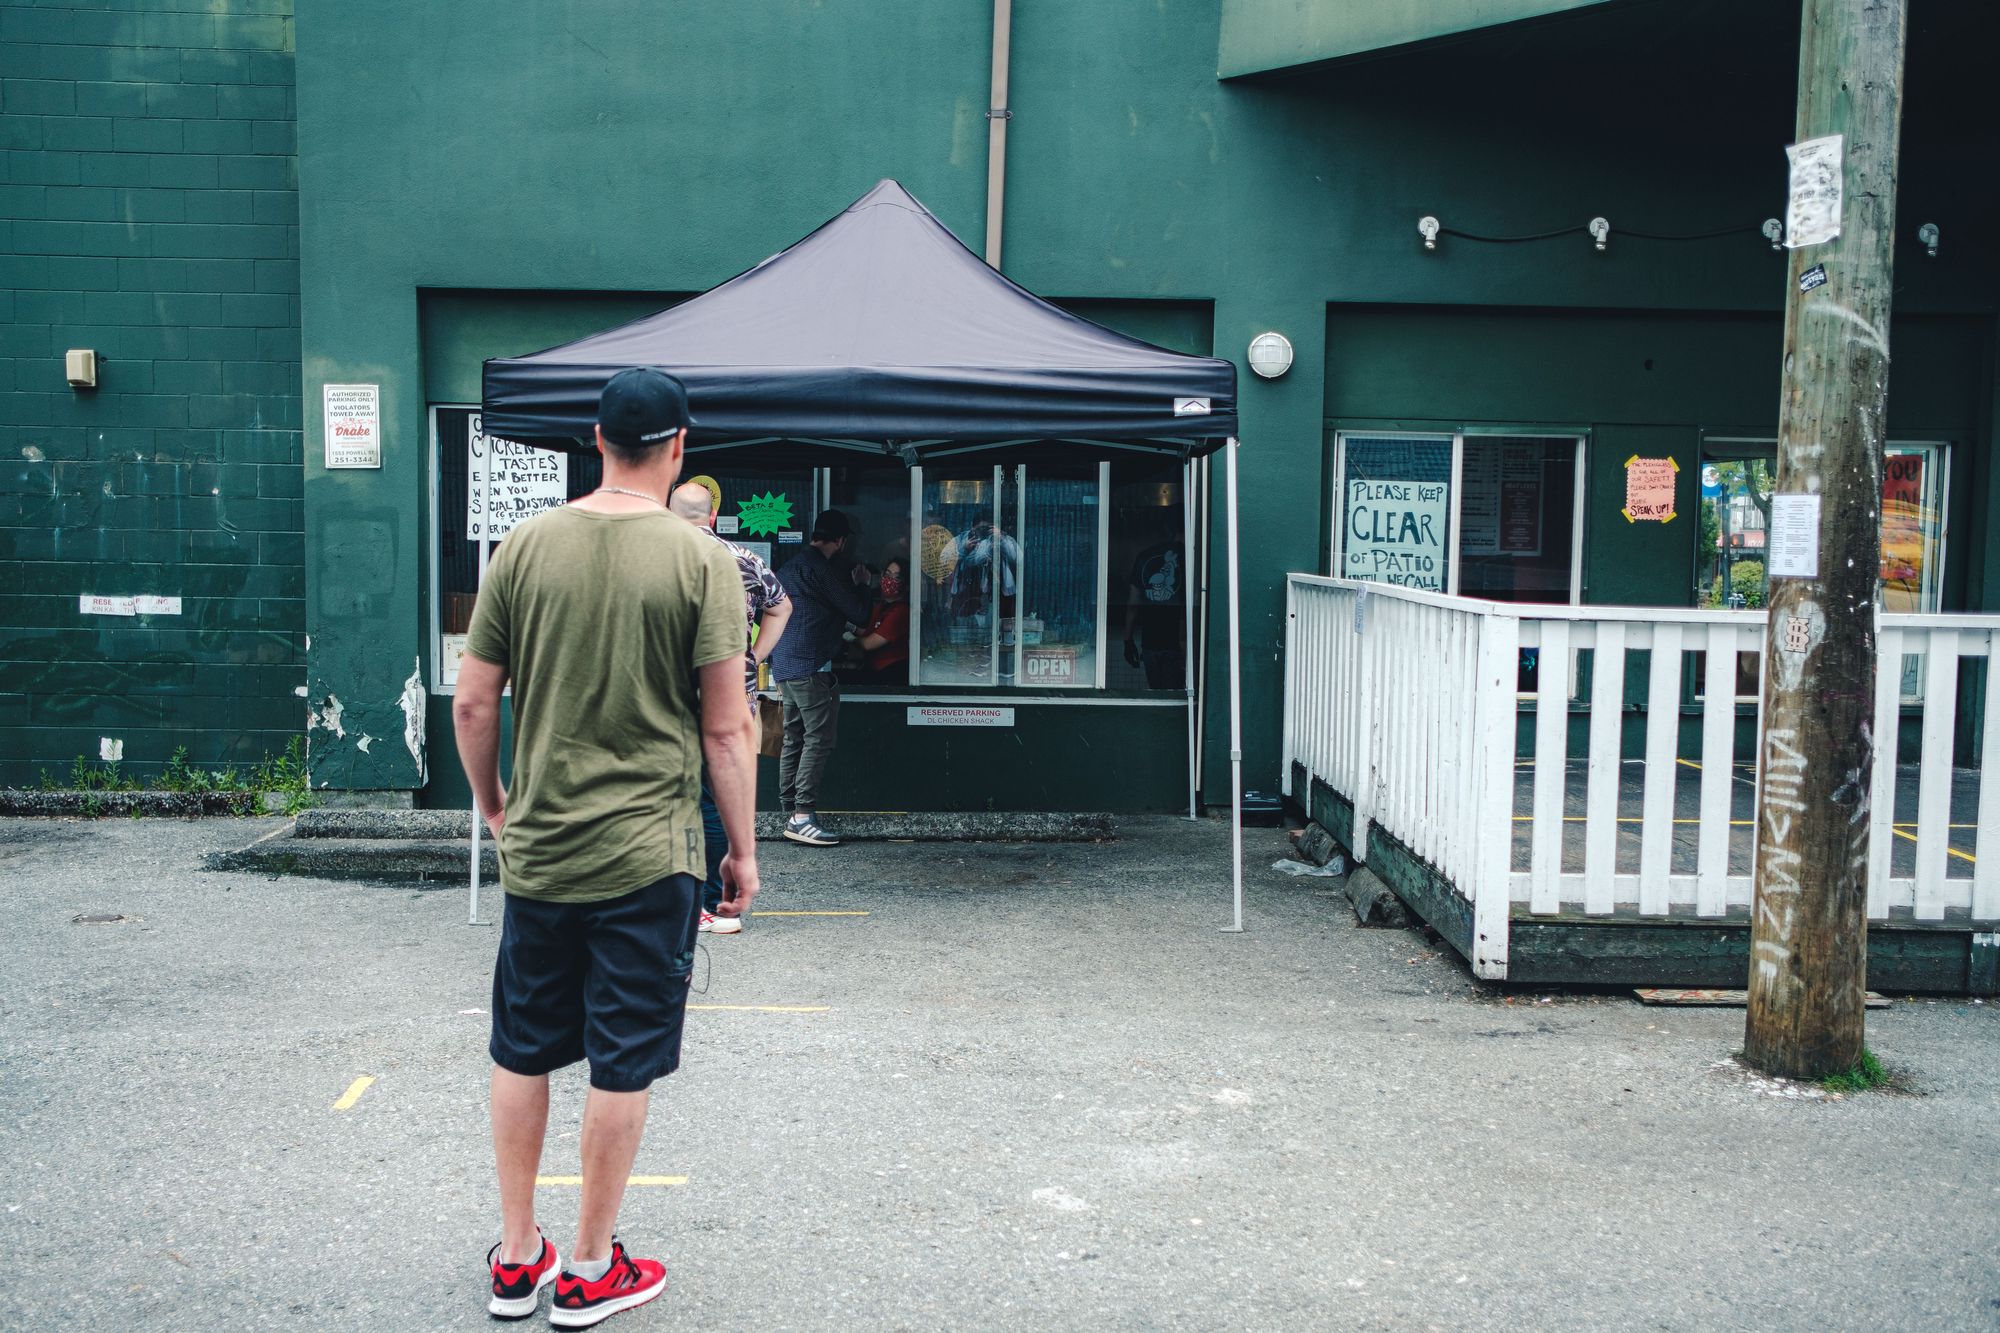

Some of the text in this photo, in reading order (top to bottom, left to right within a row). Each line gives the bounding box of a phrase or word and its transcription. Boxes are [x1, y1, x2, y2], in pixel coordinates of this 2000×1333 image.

[335, 425, 370, 436] Drake
[472, 435, 535, 458] CICKEN
[499, 455, 559, 471] TASTES
[473, 471, 560, 483] EEN BETTER
[473, 487, 501, 498] WEN
[1353, 481, 1444, 503] PLEASE KEEP
[472, 499, 513, 514] SCIAL
[1630, 503, 1669, 517] SPEAK UP!
[508, 511, 528, 519] FEET
[1352, 505, 1439, 546] CLEAR
[1350, 549, 1434, 572] OF PATIO
[1403, 574, 1439, 589] CALL
[1027, 659, 1071, 676] OPEN
[921, 709, 1001, 717] RESERVED PARKING
